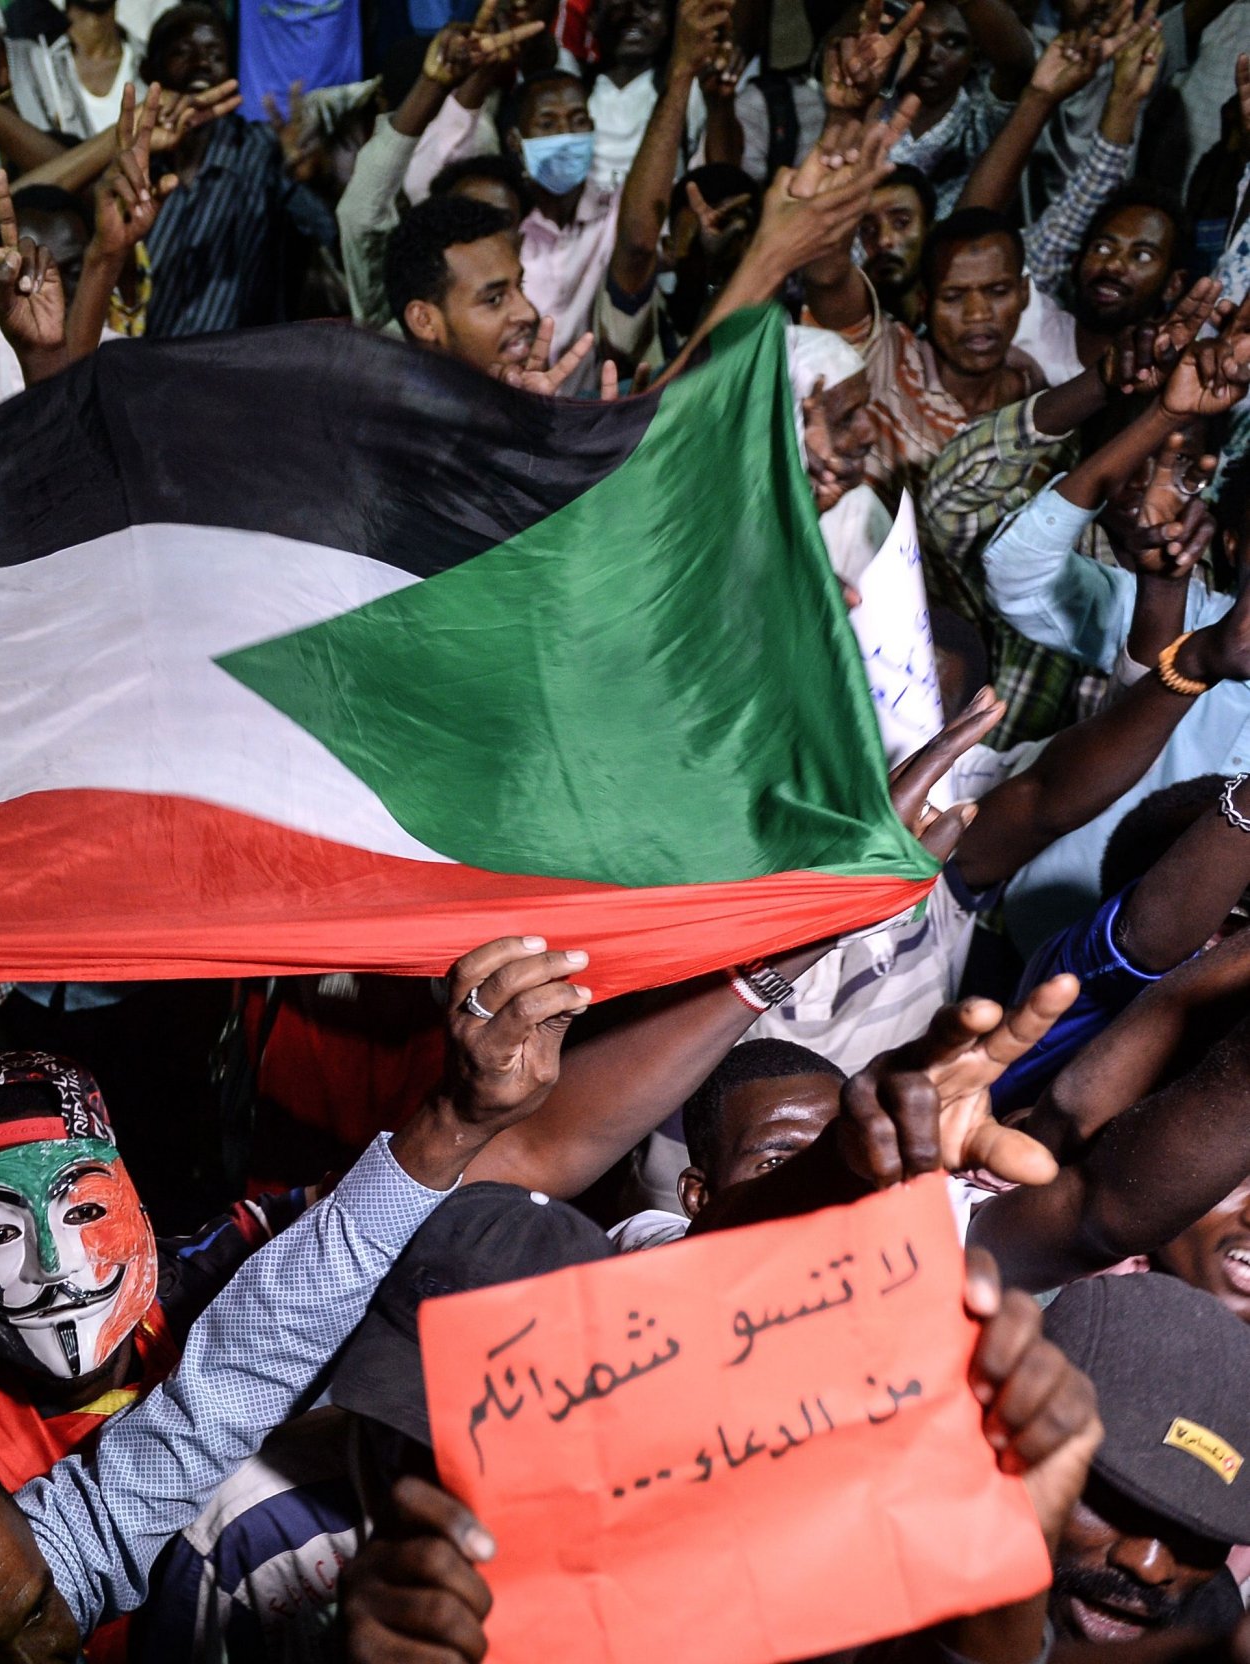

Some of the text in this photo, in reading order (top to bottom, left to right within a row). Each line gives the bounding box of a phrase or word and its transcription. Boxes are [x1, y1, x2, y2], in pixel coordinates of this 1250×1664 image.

[880, 1242, 919, 1296] لا
[723, 1253, 854, 1368] تنسو
[866, 1376, 923, 1425] من
